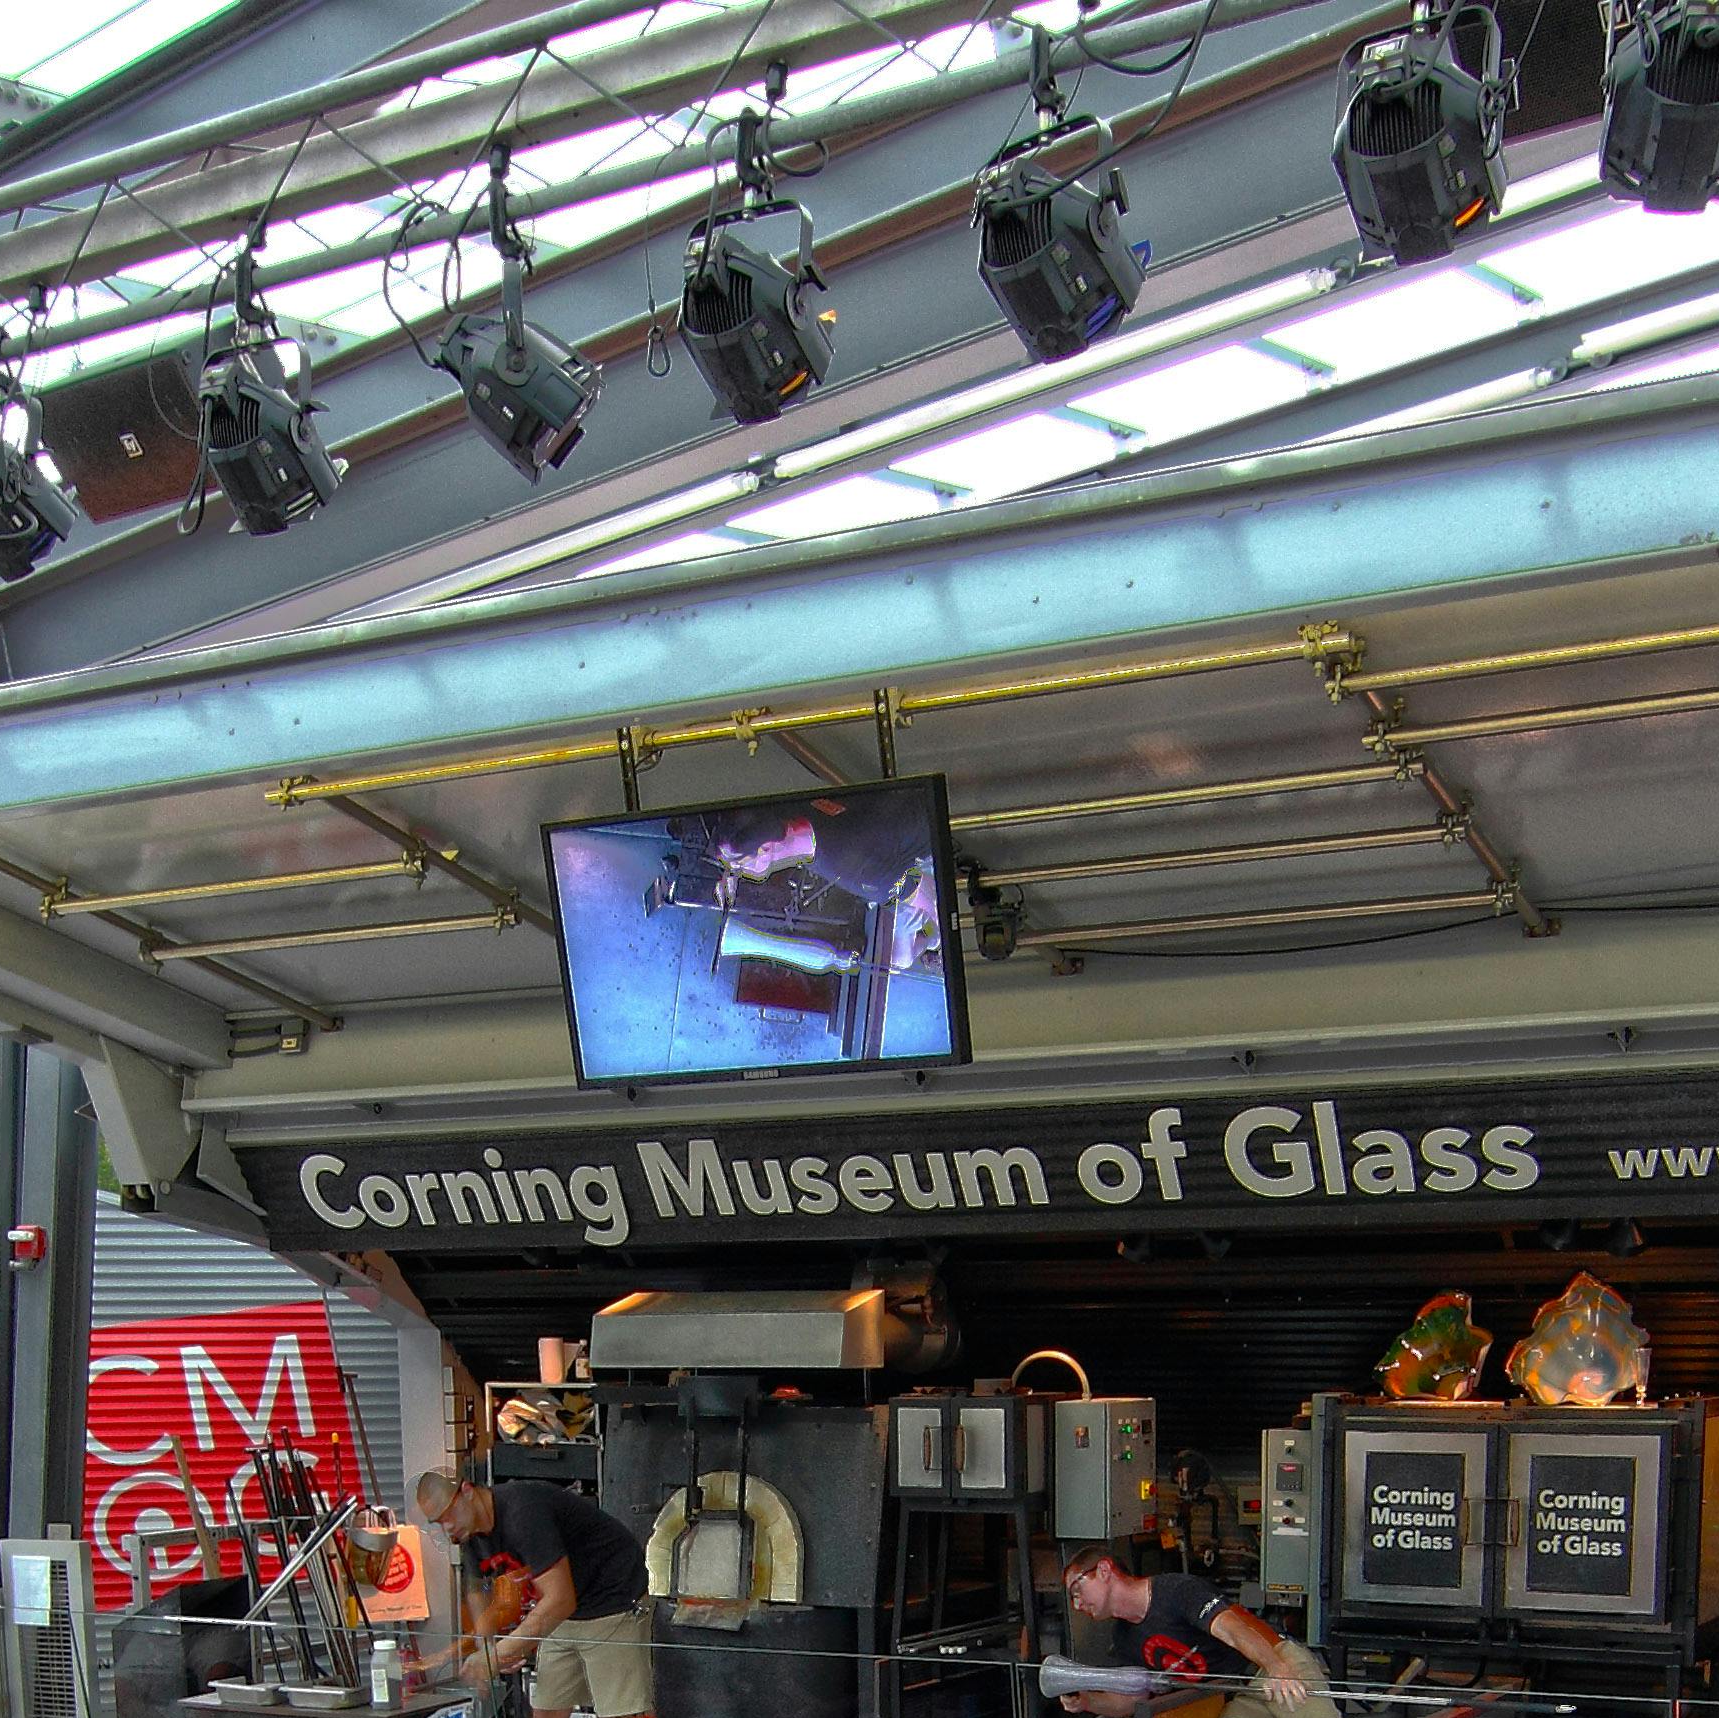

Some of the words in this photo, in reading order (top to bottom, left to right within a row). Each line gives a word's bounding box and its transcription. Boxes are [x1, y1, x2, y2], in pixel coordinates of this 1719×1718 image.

[299, 1146, 630, 1247] Corning
[636, 1138, 1051, 1218] Museum
[1076, 1106, 1188, 1205] of
[1224, 1100, 1540, 1198] Glass
[1373, 1484, 1455, 1511] Corning
[1539, 1489, 1626, 1516] Corning
[1370, 1506, 1456, 1527] Museum
[1535, 1512, 1626, 1533] Museum
[1372, 1528, 1396, 1548] of
[1397, 1530, 1453, 1550] Glass
[1537, 1534, 1562, 1554] of
[1564, 1535, 1623, 1557] Glass
